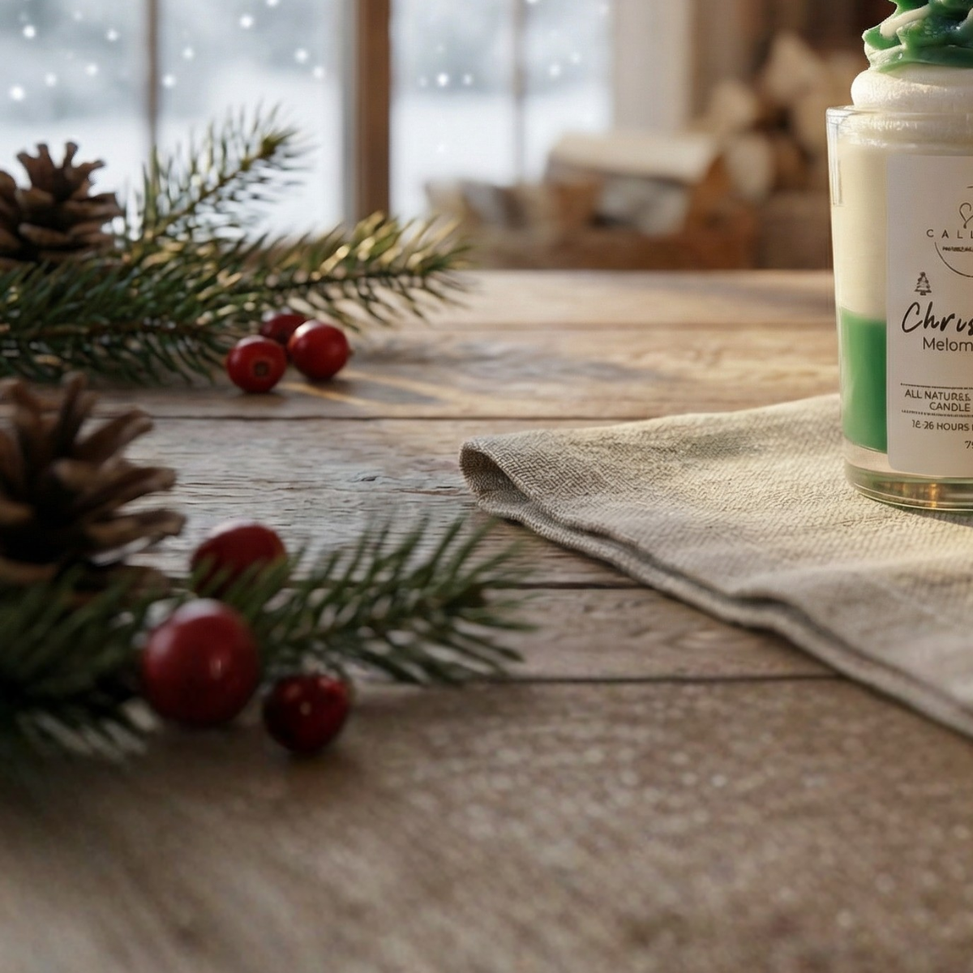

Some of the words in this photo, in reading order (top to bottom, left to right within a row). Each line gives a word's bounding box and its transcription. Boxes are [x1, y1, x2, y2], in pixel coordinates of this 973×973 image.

[904, 389, 923, 400] ALL
[929, 401, 971, 412] CANDLE
[936, 422, 970, 432] HOURS
